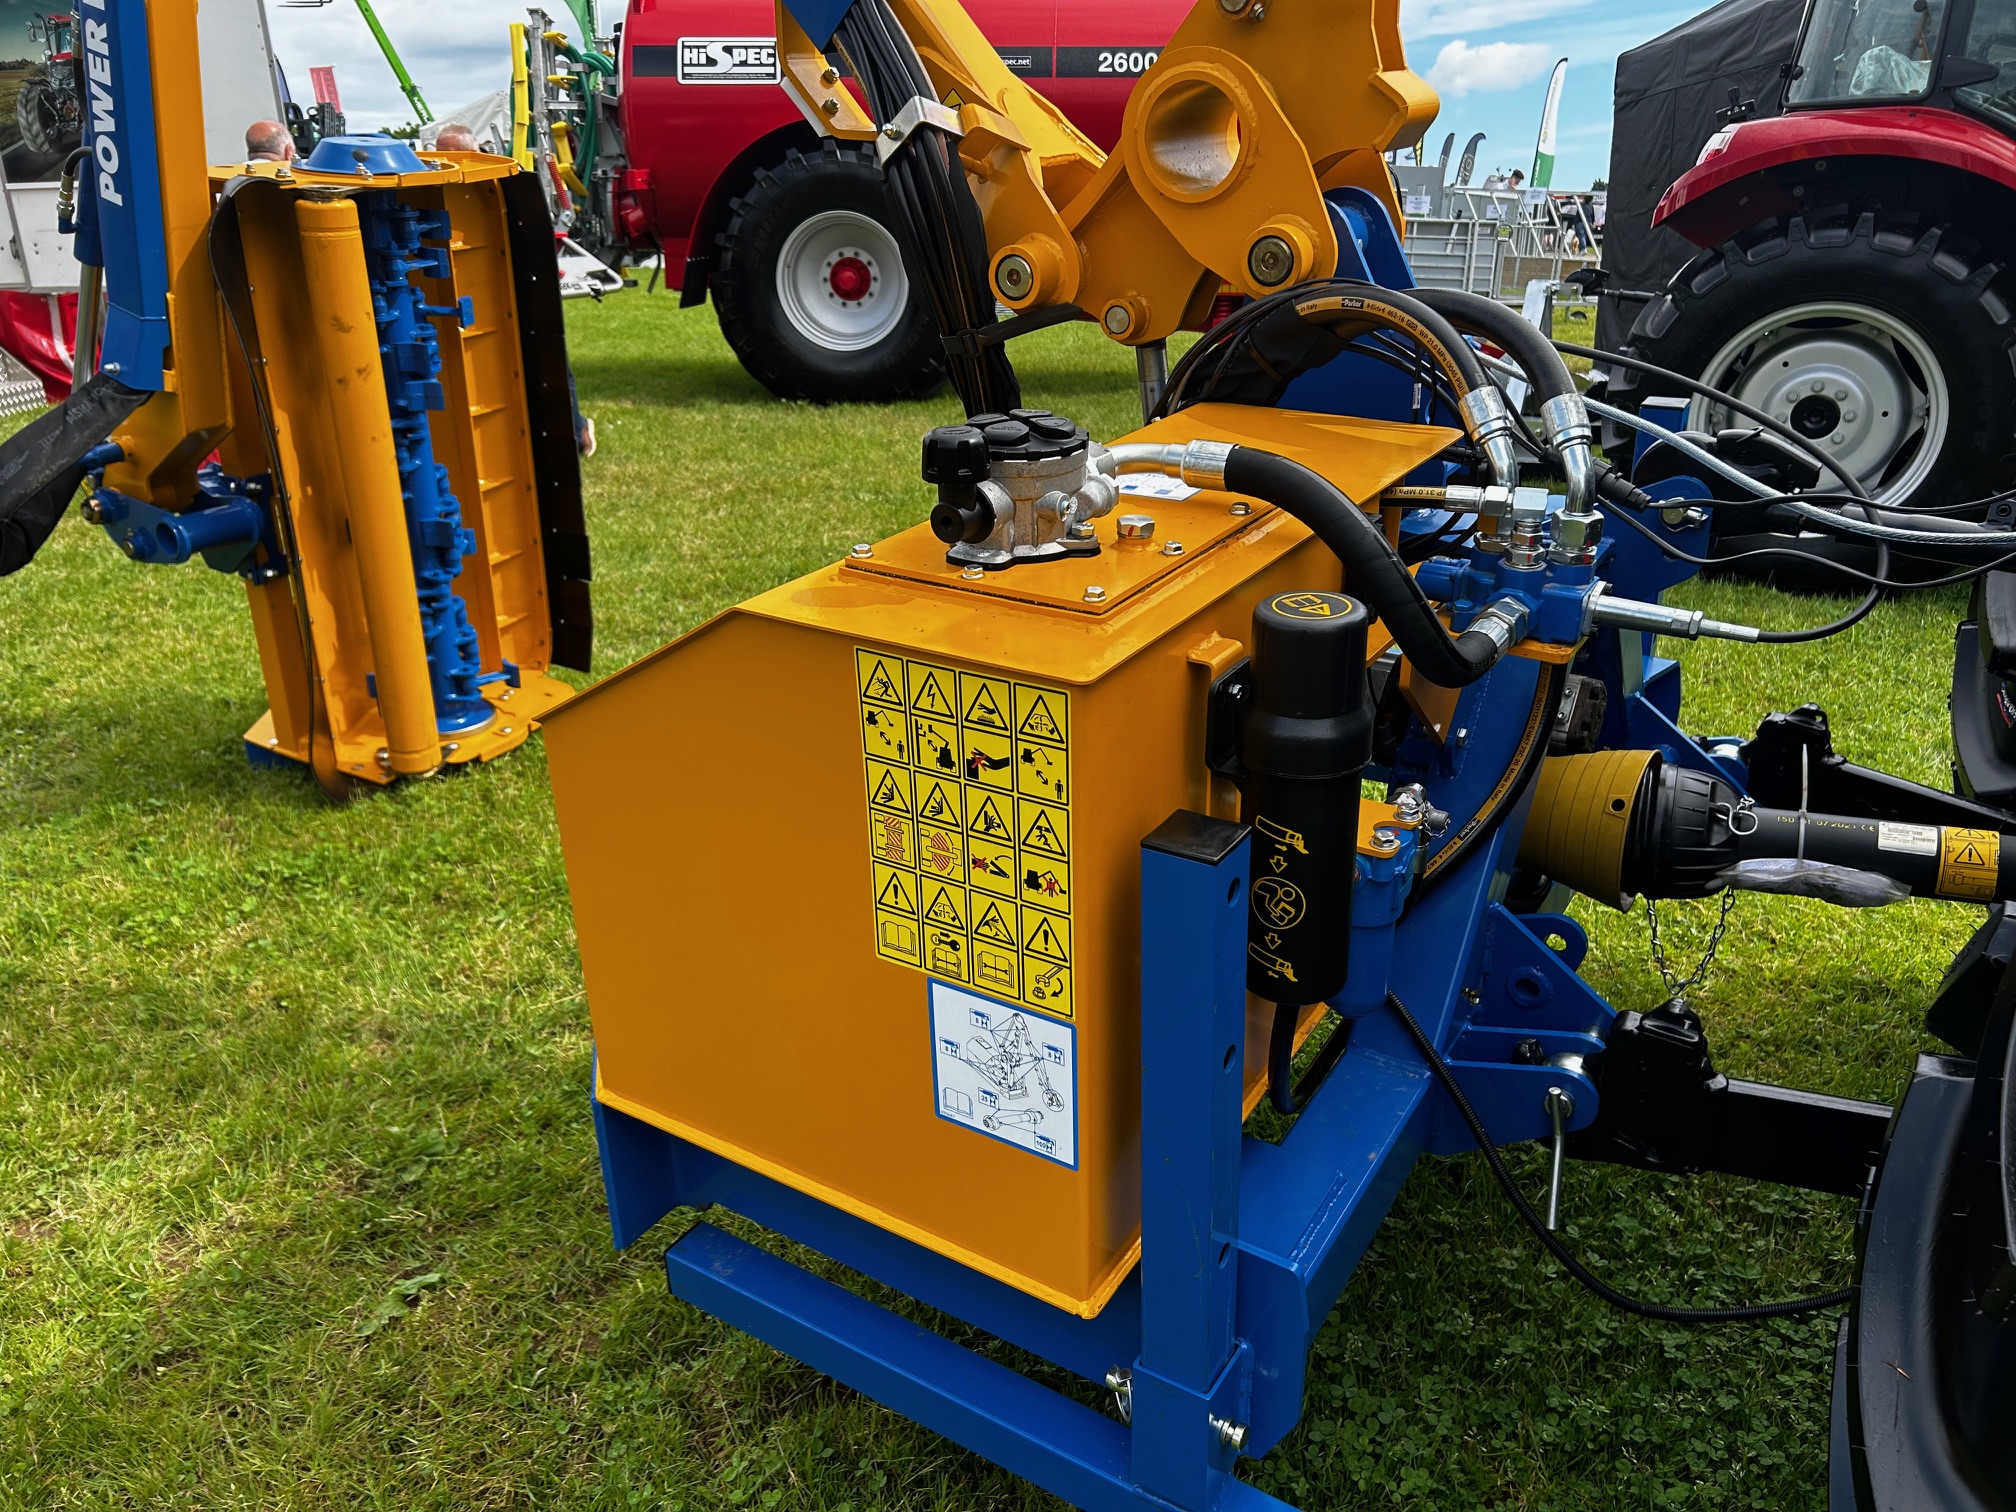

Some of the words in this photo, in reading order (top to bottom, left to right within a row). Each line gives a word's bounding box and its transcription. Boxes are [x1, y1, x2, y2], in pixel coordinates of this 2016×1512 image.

[1098, 52, 1158, 73] 2600
[85, 18, 123, 207] POWER
[1306, 302, 1318, 311] Italy
[1343, 299, 1362, 308] Parker
[1387, 310, 1405, 323] 462-16
[1419, 329, 1429, 339] WP
[1427, 337, 1438, 350] 21.0
[1436, 347, 1447, 363] MPa
[65, 401, 95, 424] MSHA
[1504, 767, 1516, 783] Made
[1491, 789, 1503, 802] Italy
[1459, 820, 1477, 838] Parker
